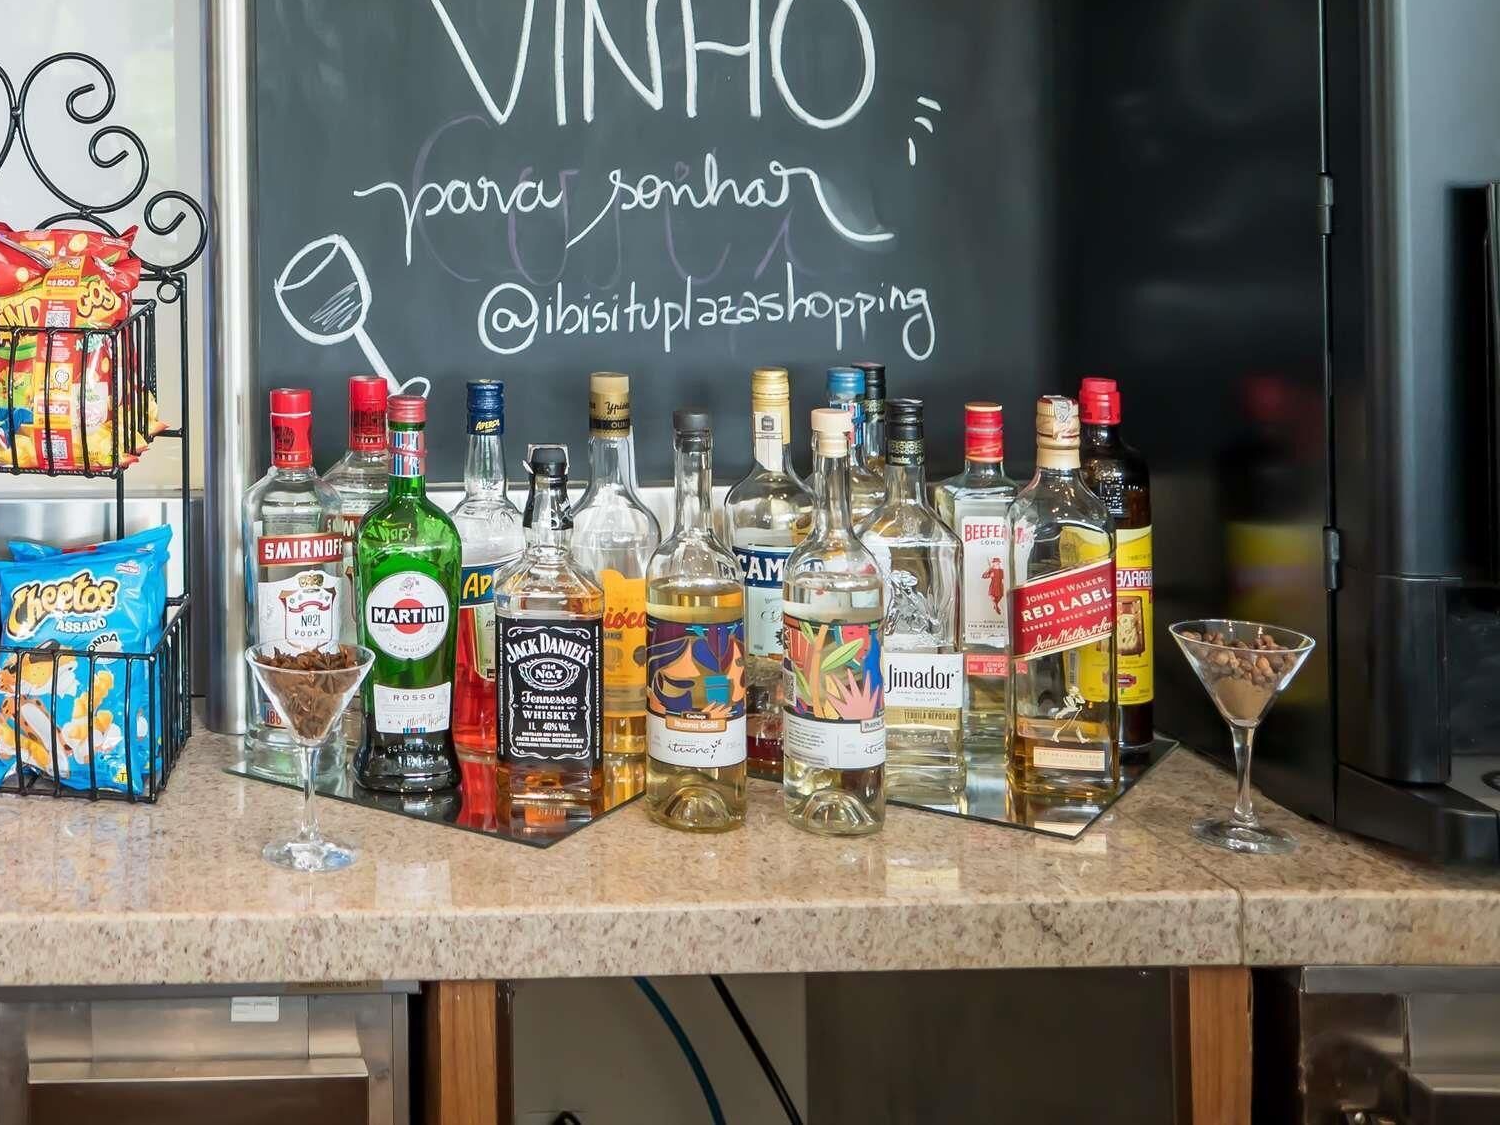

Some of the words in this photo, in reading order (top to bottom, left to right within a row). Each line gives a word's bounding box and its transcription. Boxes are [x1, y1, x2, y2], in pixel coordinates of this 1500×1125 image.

[352, 178, 566, 266] para
[566, 153, 895, 249] sonhar
[478, 261, 937, 362] @ibisituplazashopping
[8, 572, 118, 638] Cheetos
[1021, 603, 1055, 622] RED
[1058, 587, 1112, 611] LABEL
[1026, 588, 1064, 605] JOHNNIE
[373, 607, 443, 624] MARTINI
[56, 617, 107, 633] ASSADO
[294, 628, 325, 637] VODKA
[88, 633, 118, 652] ONDA
[505, 638, 540, 664] JACK
[540, 632, 594, 666] DANIEL'S
[884, 663, 955, 694] Jimador
[393, 693, 436, 703] ROSSO
[521, 690, 578, 705] Tennessee
[522, 710, 577, 721] WHISKEY
[542, 722, 558, 732] 40%
